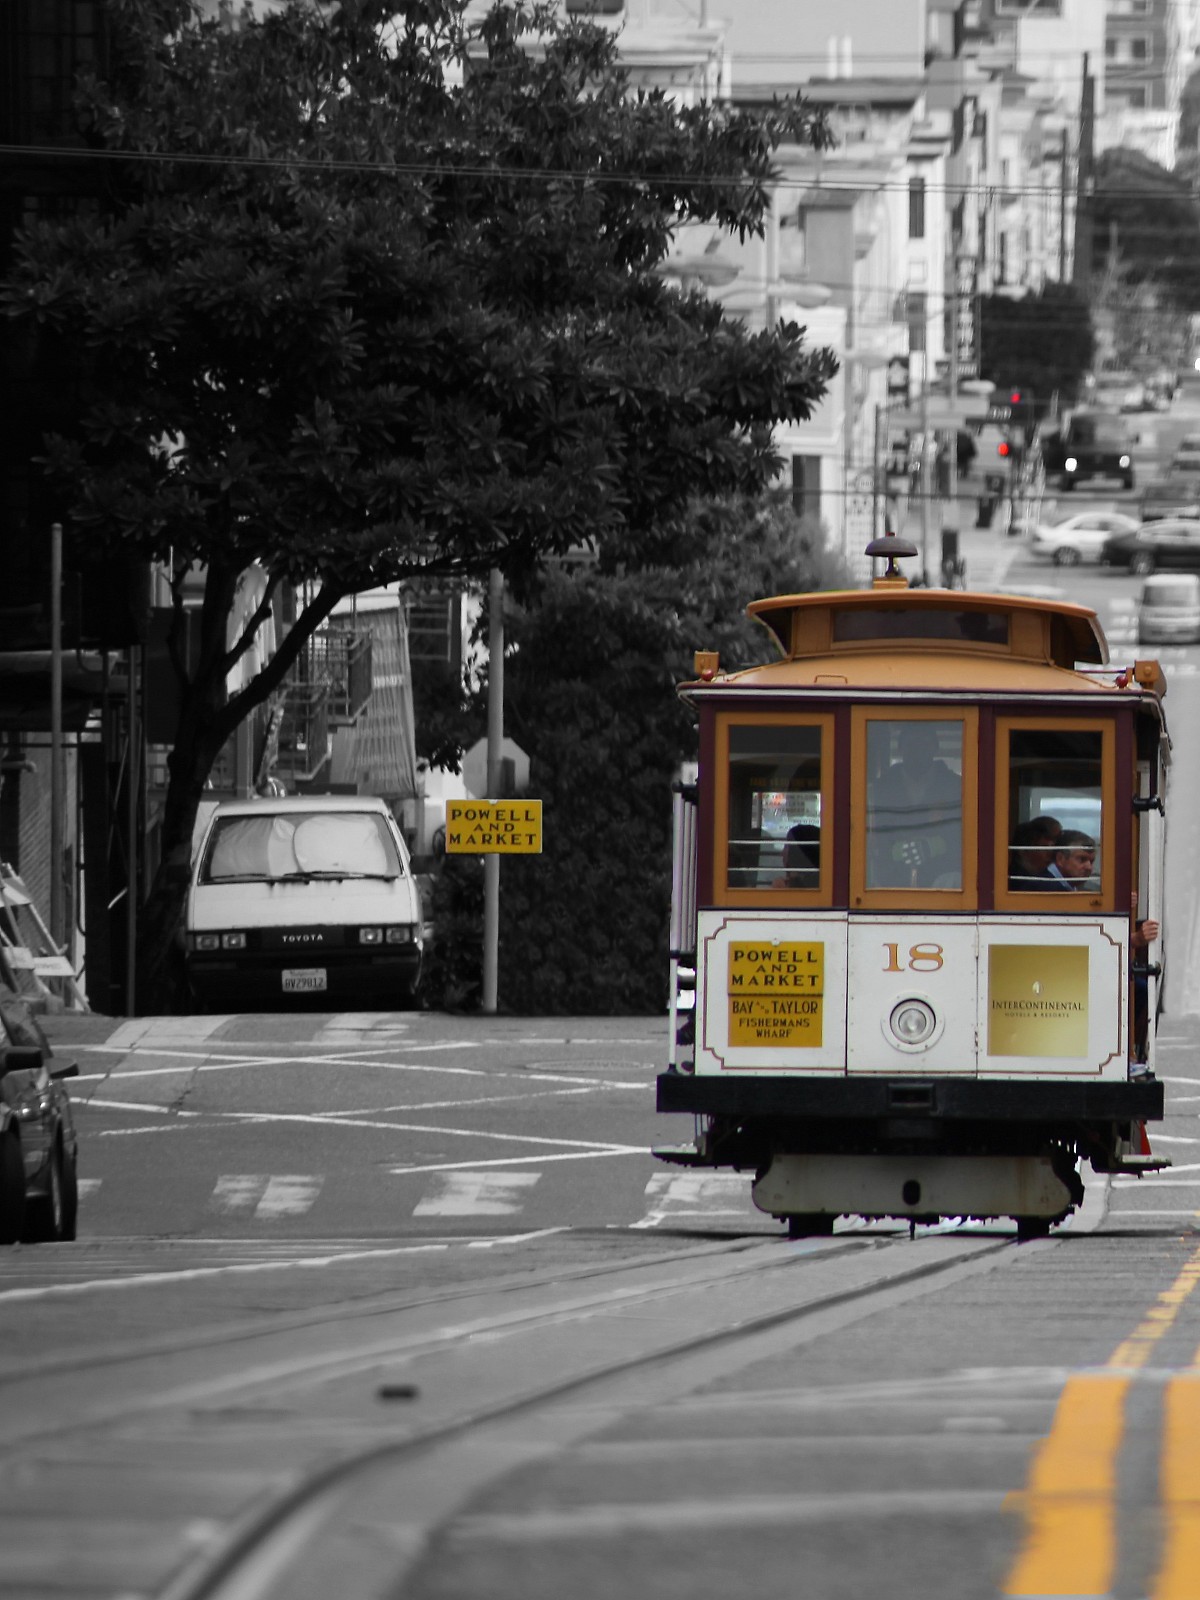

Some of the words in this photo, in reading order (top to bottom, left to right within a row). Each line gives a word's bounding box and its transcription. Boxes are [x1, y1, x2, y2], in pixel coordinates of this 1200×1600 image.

[450, 808, 535, 821] POWELL
[473, 823, 515, 832] AND
[449, 833, 537, 845] MARKET
[282, 933, 323, 943] TOYOTA
[733, 950, 818, 962] POWELL
[881, 942, 944, 972] 18
[755, 964, 797, 973] AND
[731, 974, 819, 986] MARKET
[732, 1000, 754, 1014] BAY
[772, 1000, 819, 1014] TAYLOR
[738, 1017, 810, 1027] FISHERMANS
[756, 1028, 792, 1038] WHARF
